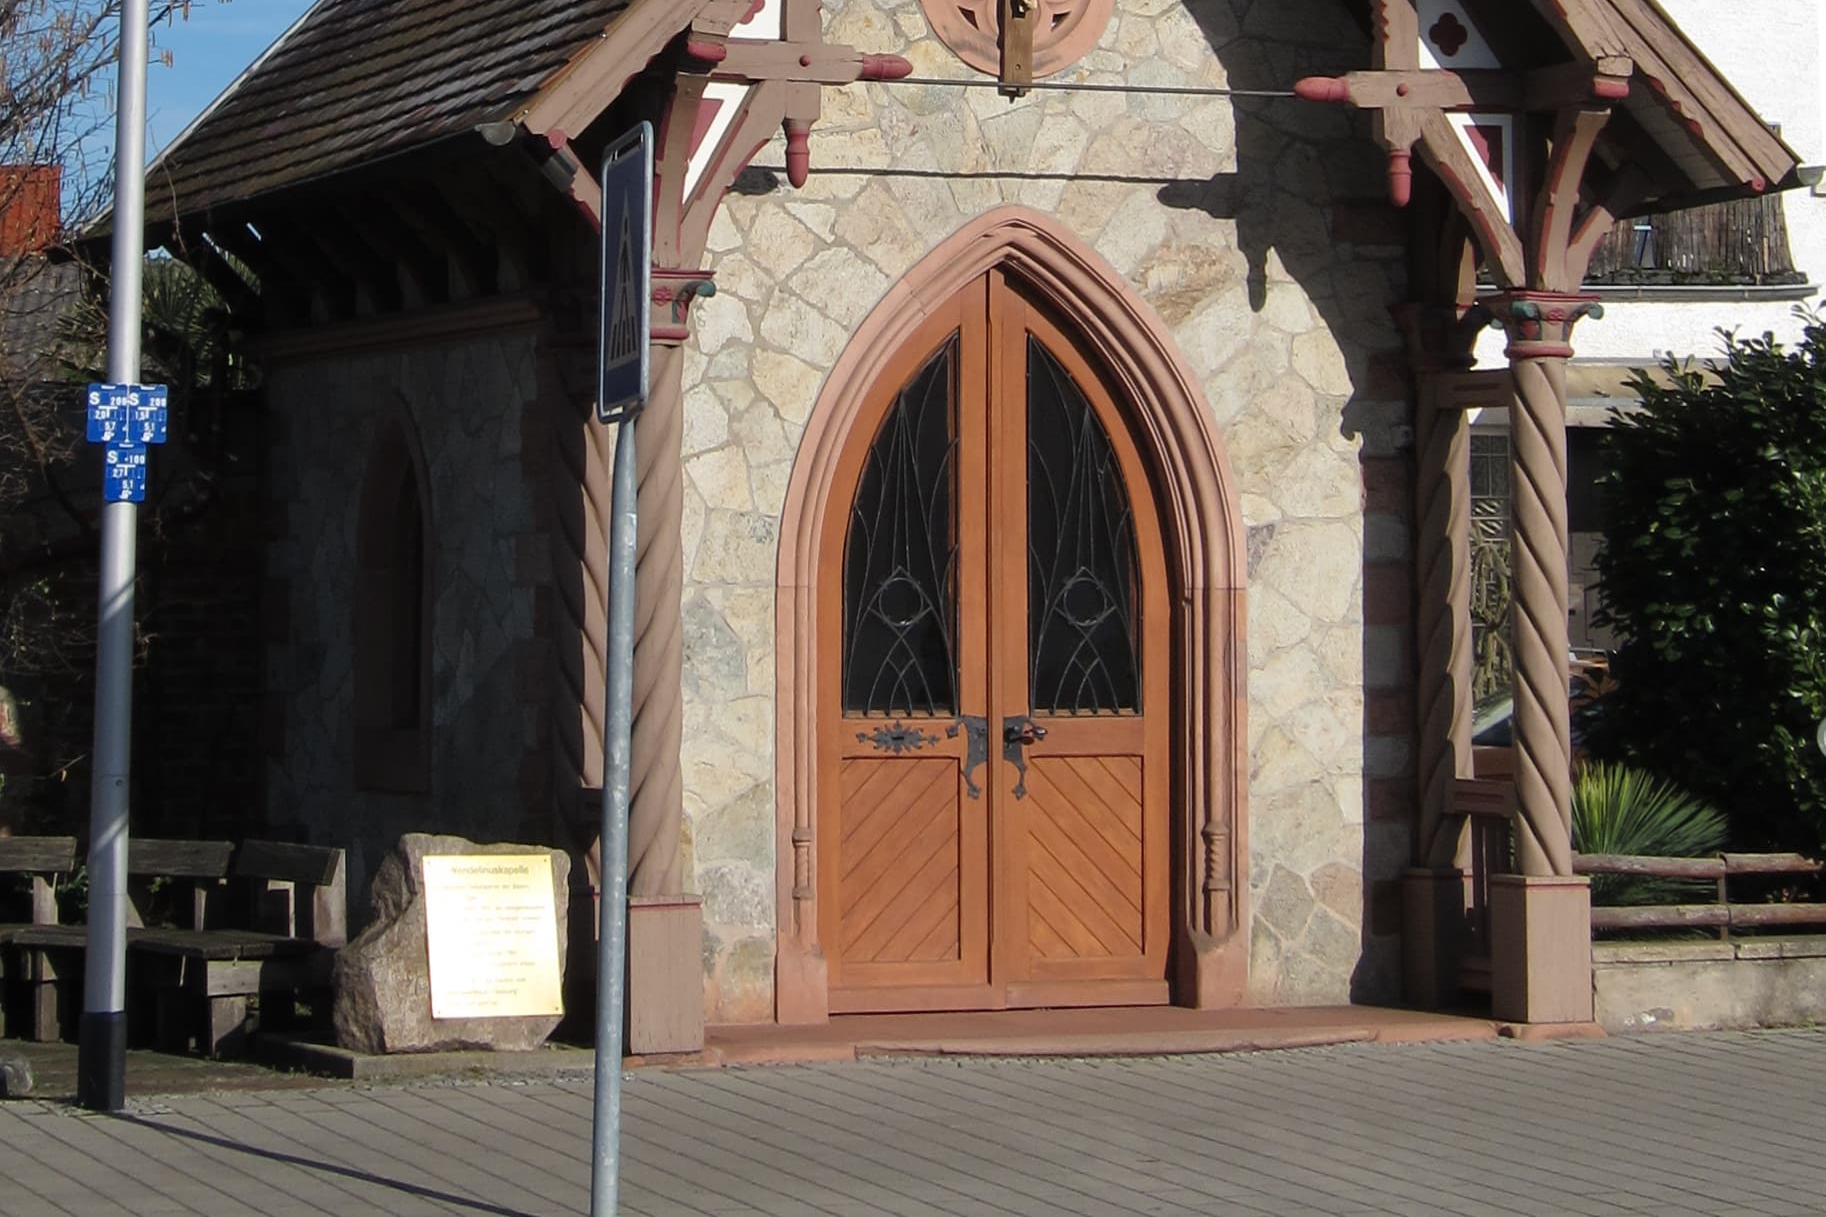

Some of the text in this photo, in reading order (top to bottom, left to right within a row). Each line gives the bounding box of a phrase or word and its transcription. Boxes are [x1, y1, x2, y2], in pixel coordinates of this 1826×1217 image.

[89, 391, 100, 406] S
[128, 392, 139, 406] S
[106, 450, 118, 464] S
